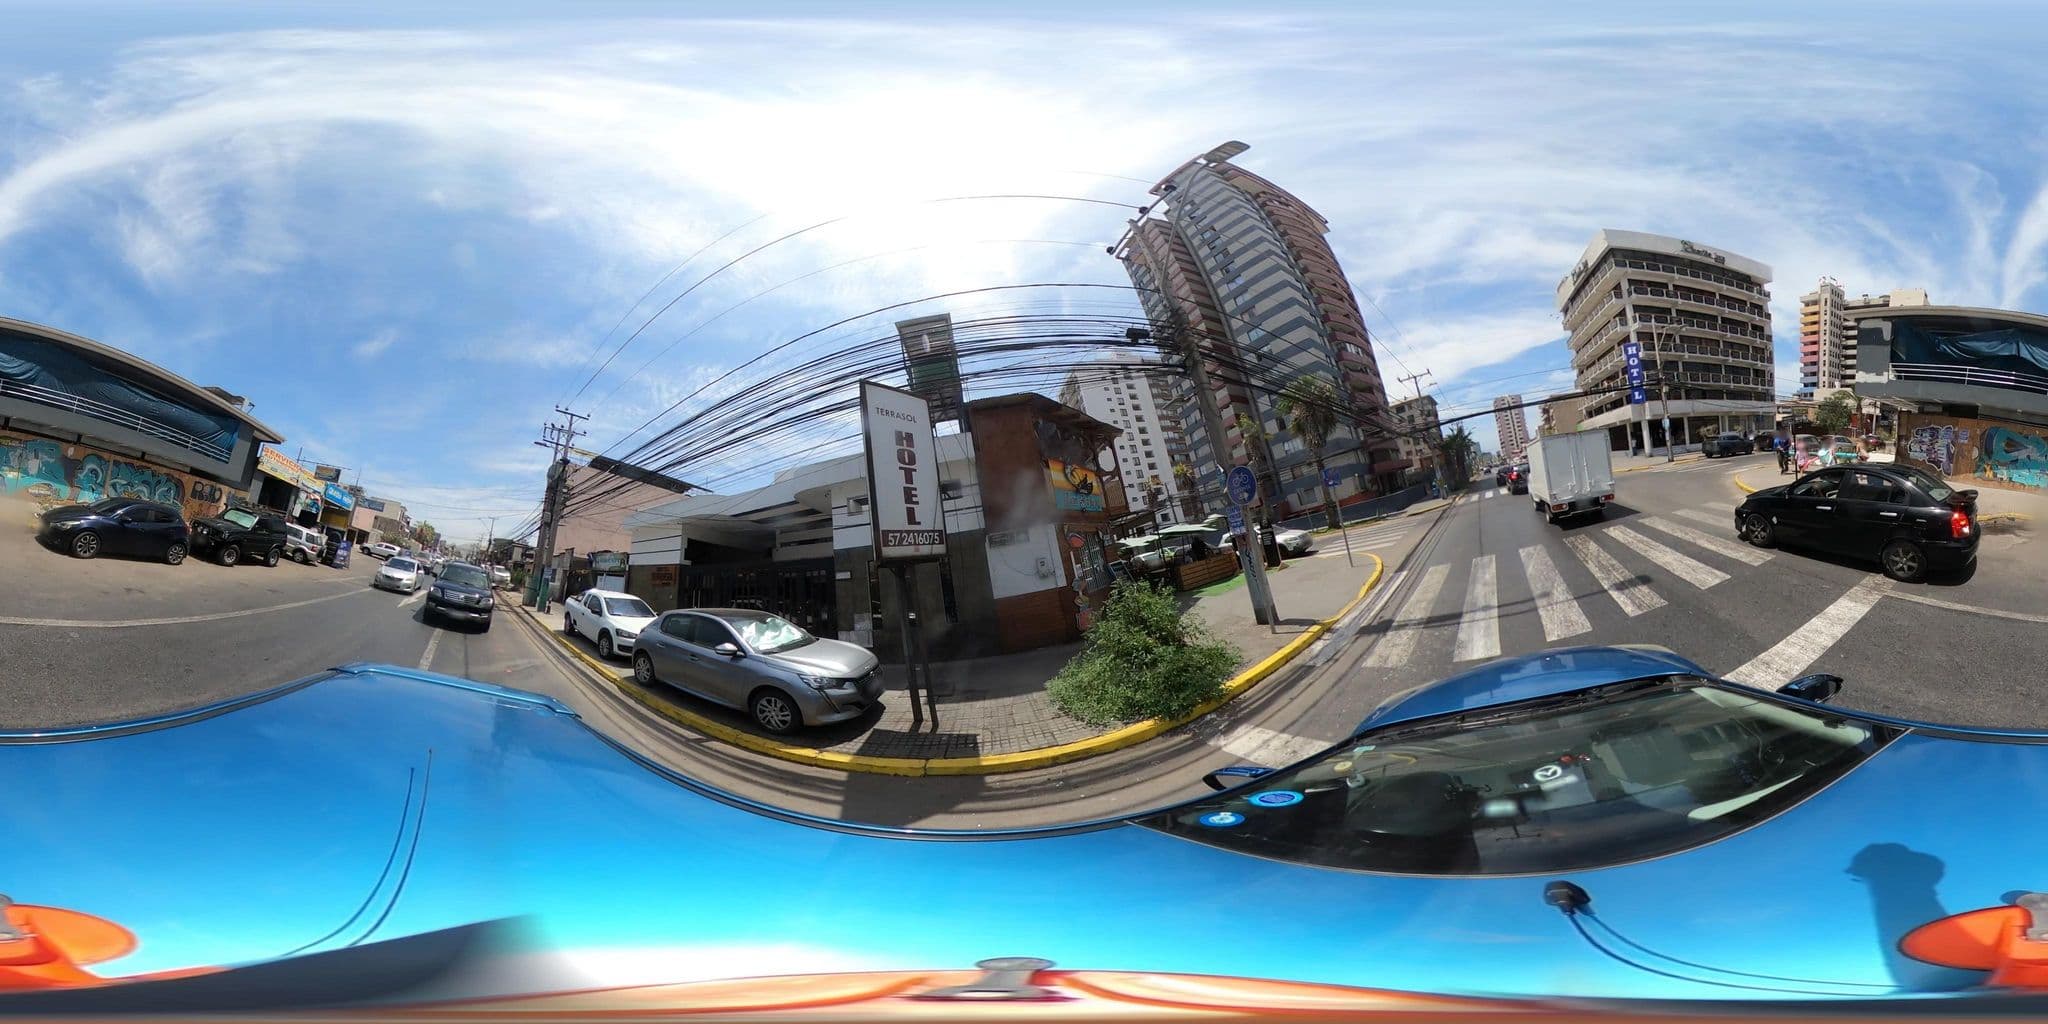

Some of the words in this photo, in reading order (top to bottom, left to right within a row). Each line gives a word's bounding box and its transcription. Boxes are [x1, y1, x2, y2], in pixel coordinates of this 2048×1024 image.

[1627, 346, 1642, 399] HOTEL
[876, 407, 918, 424] TERRASOL
[895, 430, 921, 525] HOTEL
[888, 535, 900, 545] 57
[902, 533, 940, 544] 2416075
